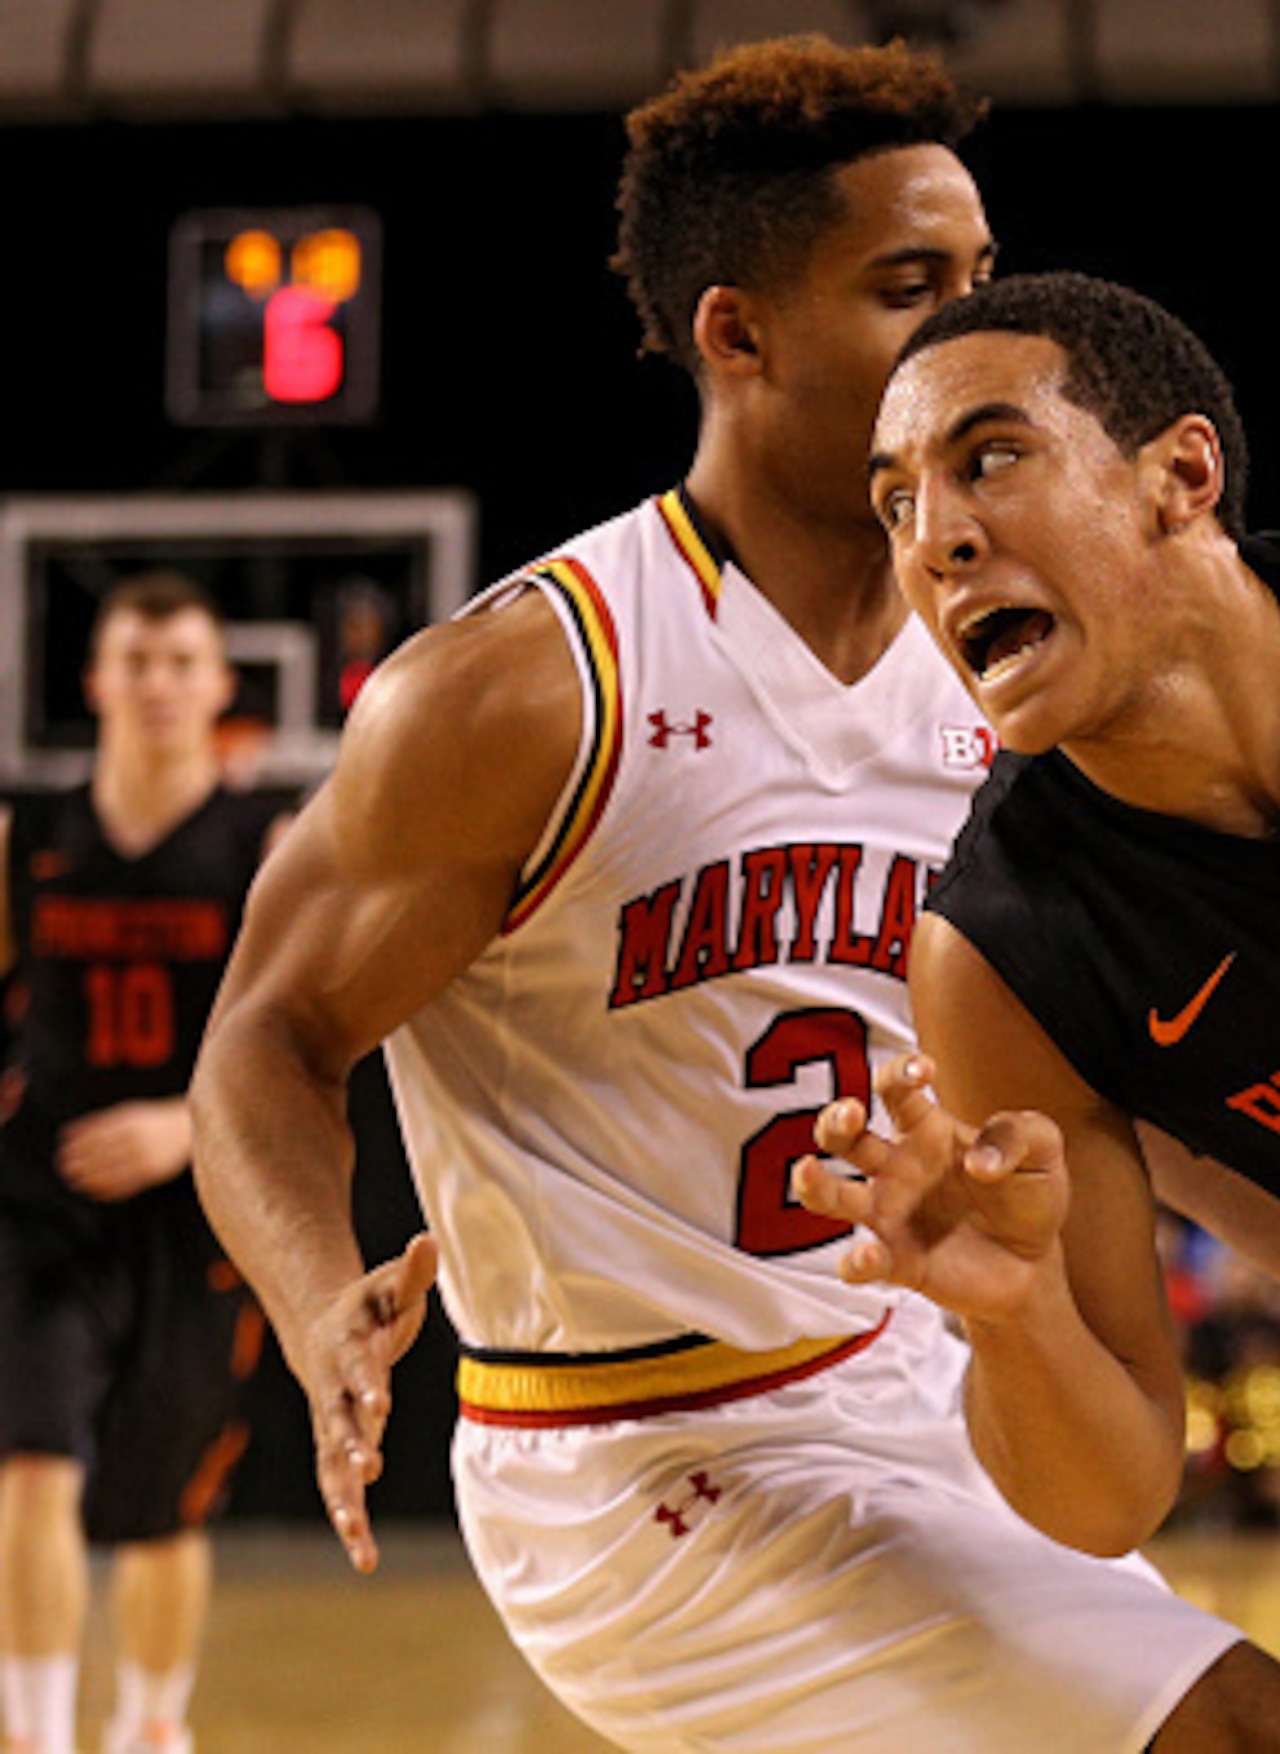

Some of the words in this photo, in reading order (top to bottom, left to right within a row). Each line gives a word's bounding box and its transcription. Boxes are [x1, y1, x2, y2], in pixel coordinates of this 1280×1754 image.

[608, 842, 942, 1010] MARYLA
[87, 966, 175, 1066] 10
[734, 1006, 871, 1259] 2
